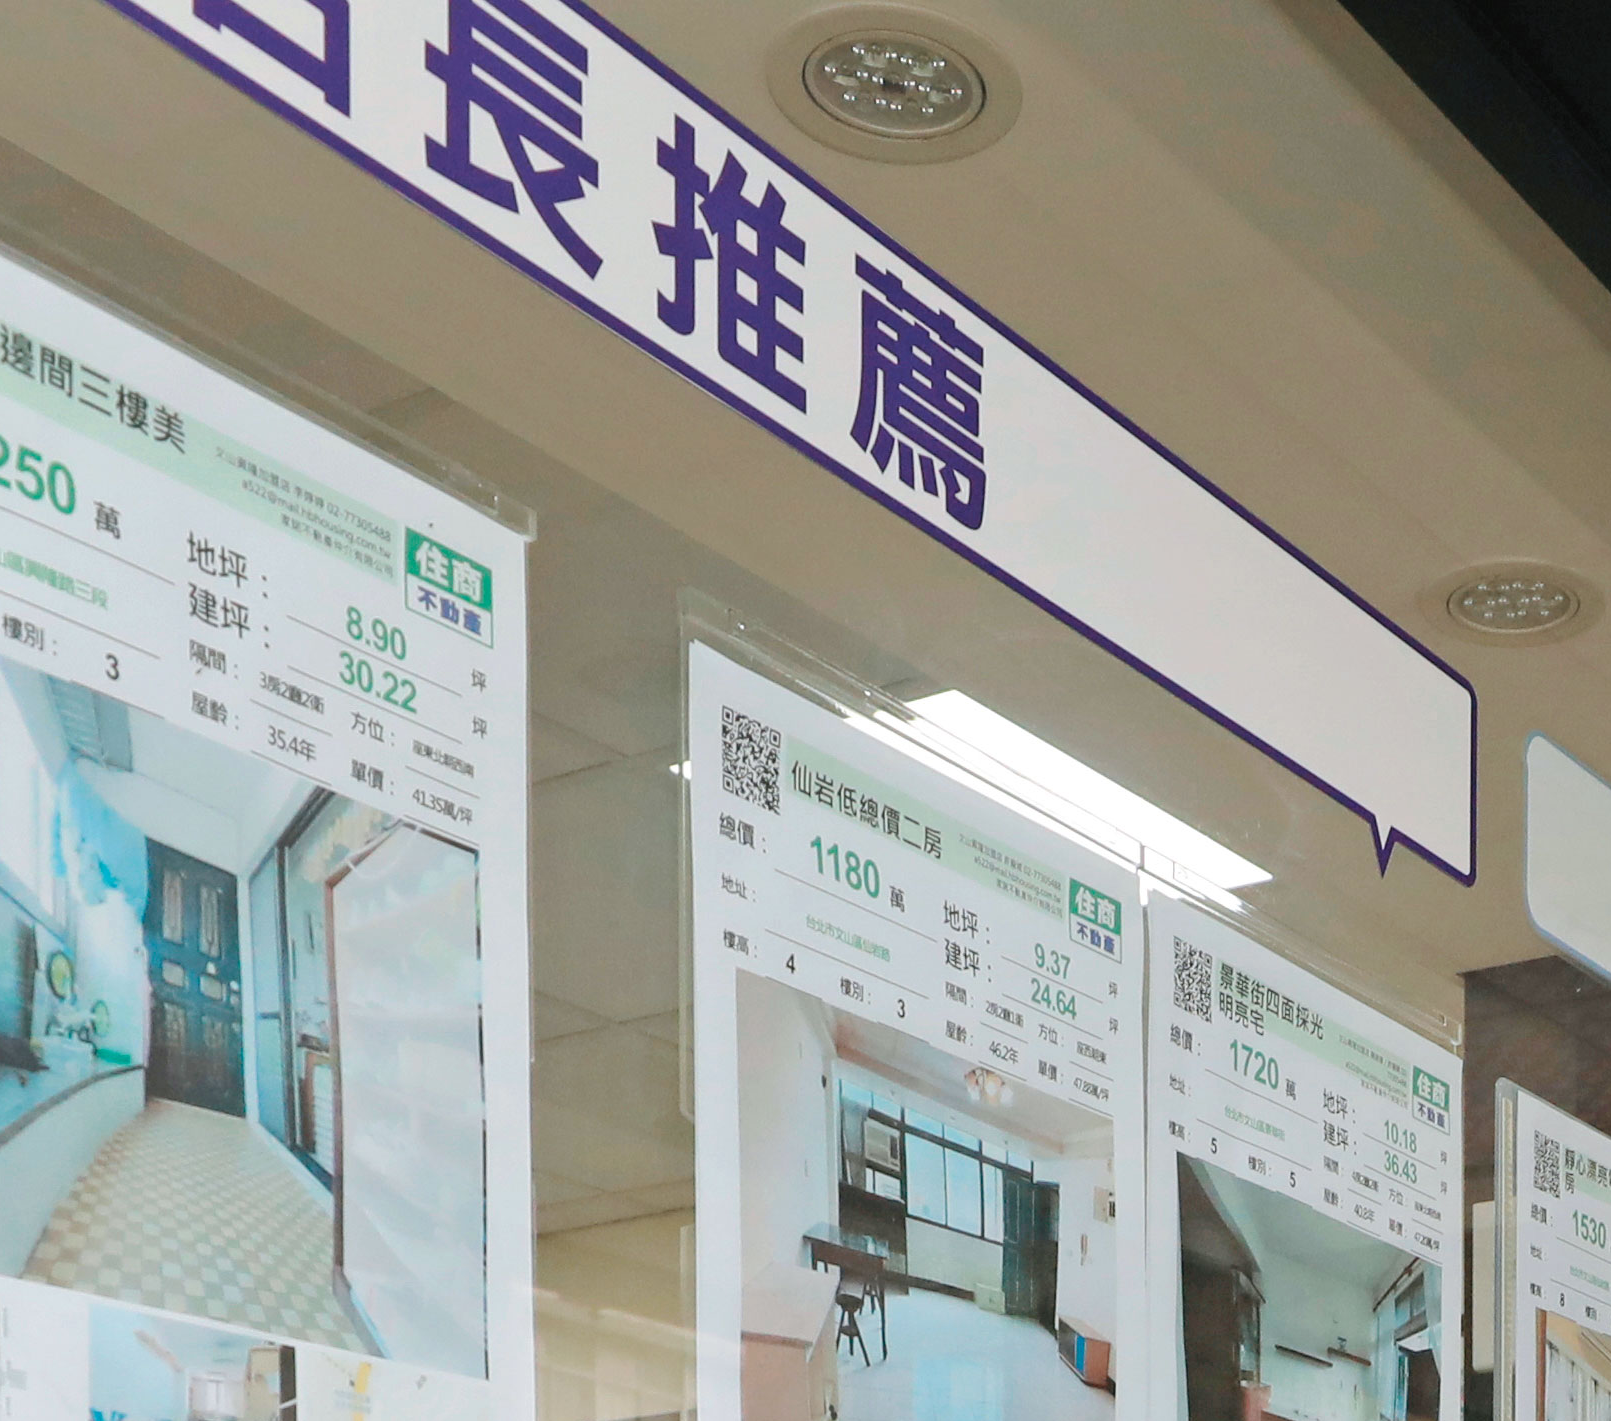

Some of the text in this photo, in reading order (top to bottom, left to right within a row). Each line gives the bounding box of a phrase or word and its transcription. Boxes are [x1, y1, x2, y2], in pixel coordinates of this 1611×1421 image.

[94, 501, 121, 540] 萬
[415, 541, 485, 605] 住商
[417, 586, 482, 637] 不動產
[104, 655, 121, 681] 3
[346, 606, 407, 660] 8.90
[471, 668, 487, 694] 坪
[339, 651, 417, 714] 30.22
[472, 715, 487, 738] 坪
[791, 760, 942, 859] 仙岩低總價二房
[810, 835, 906, 913] 1180 萬
[1072, 884, 1118, 928] 住商
[1076, 922, 1115, 956] 不動產
[1034, 943, 1070, 980] 9.37
[786, 954, 907, 1018] 4 3
[1030, 978, 1077, 1020] 24.64
[1219, 997, 1265, 1036] 明亮宅
[1230, 1039, 1279, 1090] 1720
[1416, 1072, 1446, 1106] 住商
[1384, 1119, 1418, 1153] 10.18
[1384, 1151, 1418, 1184] 36.43
[1571, 1209, 1606, 1249] 1530
